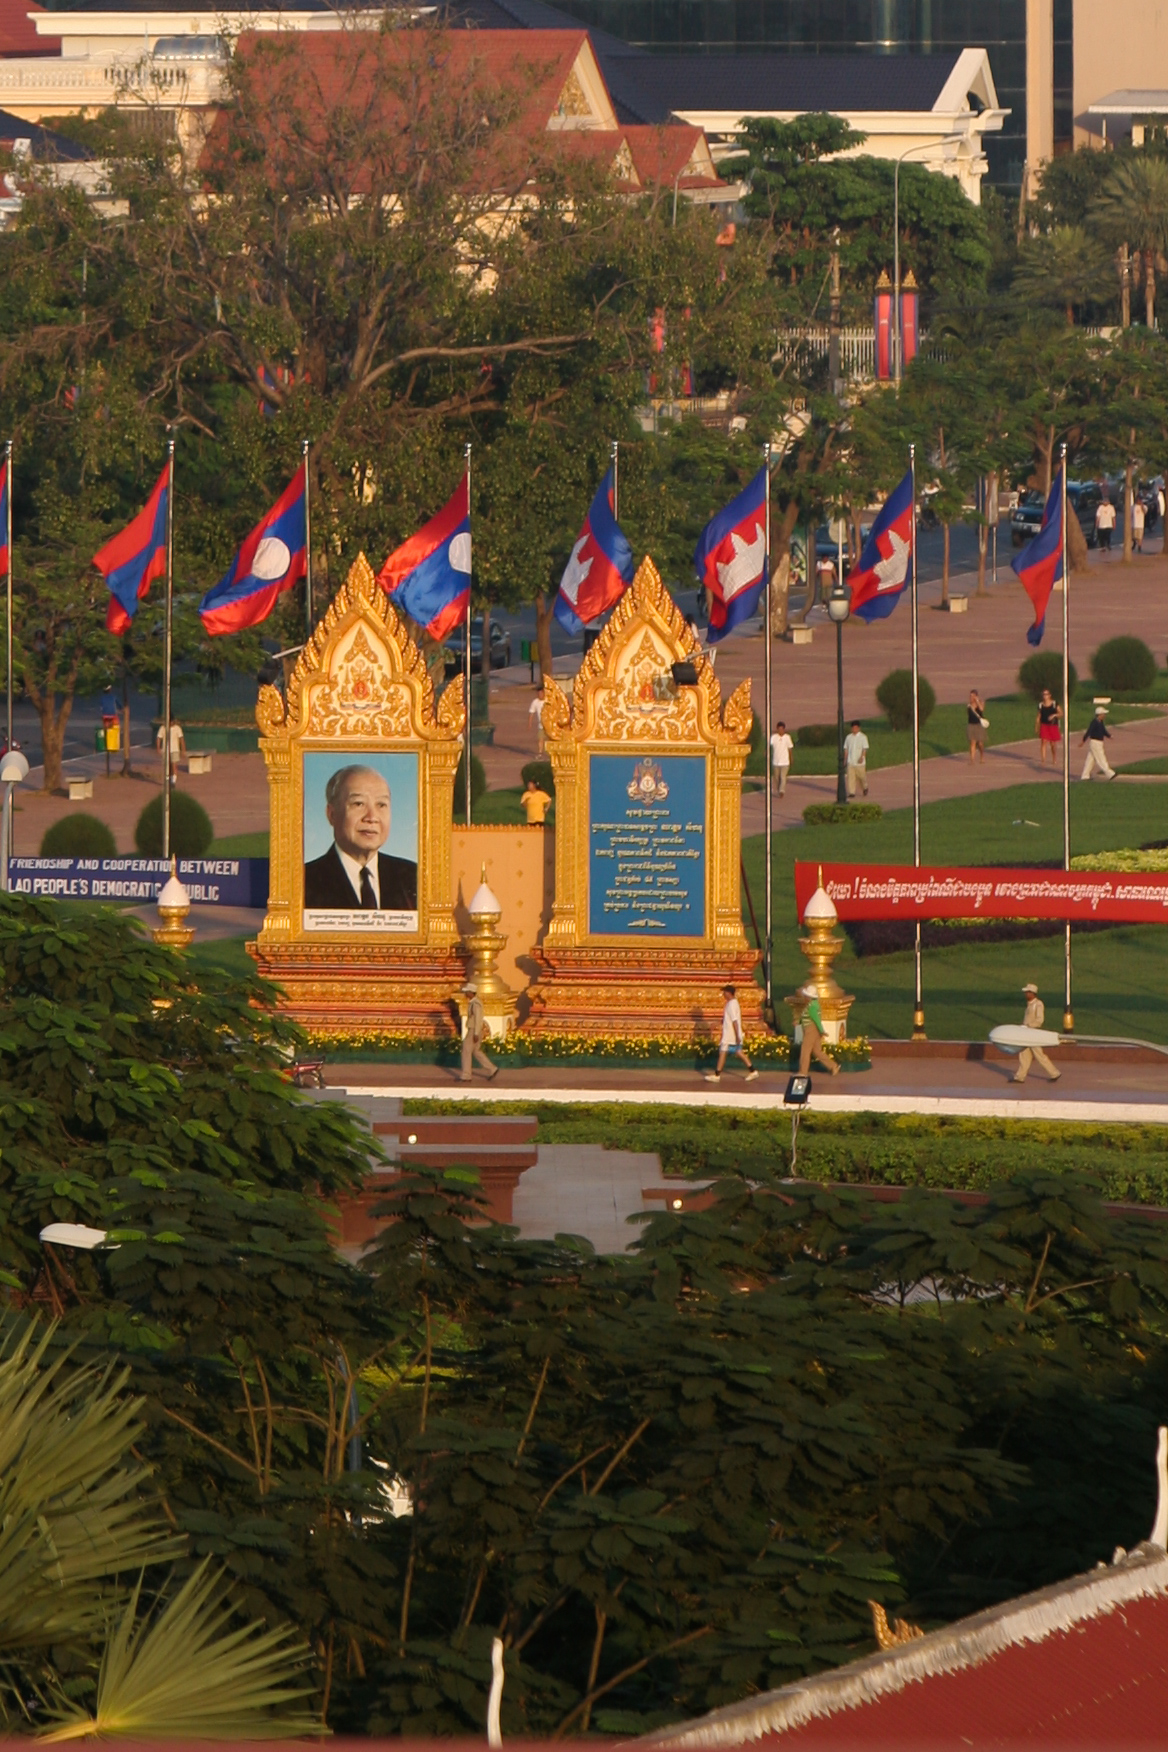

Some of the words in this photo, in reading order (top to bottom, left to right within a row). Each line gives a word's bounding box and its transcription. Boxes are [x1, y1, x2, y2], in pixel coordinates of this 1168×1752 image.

[9, 858, 74, 870] FRIENDSHIP
[76, 859, 99, 870] AND
[102, 859, 172, 872] COOPERATIO
[179, 860, 240, 876] BETWEEN
[8, 877, 32, 894] LAO
[33, 878, 89, 896] PEOPLE'S
[92, 879, 162, 898] DEMOCRATIC
